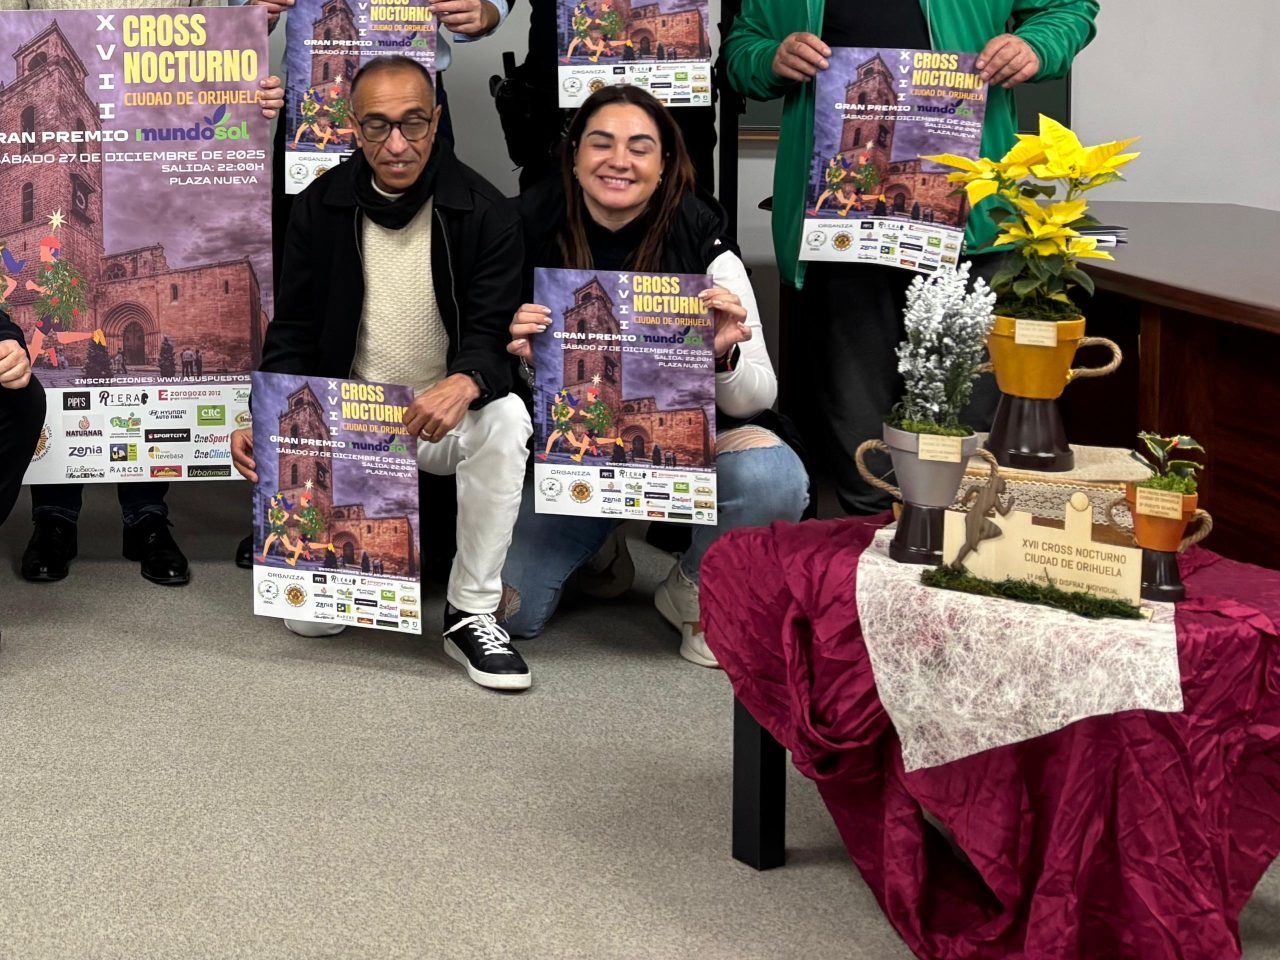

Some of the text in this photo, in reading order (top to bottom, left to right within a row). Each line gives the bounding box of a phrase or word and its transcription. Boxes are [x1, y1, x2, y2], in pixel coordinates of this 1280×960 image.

[371, 6, 433, 21] NOCTURNO
[123, 14, 206, 47] CROSS
[124, 49, 258, 84] NOCTURNO
[913, 53, 959, 69] CROSS
[911, 70, 985, 89] NOCTURNO
[124, 90, 261, 107] CIUDAD DE ORIHUELA
[867, 104, 911, 112] PREMIO
[42, 130, 129, 143] PREMIO
[59, 153, 76, 164] 27
[80, 153, 101, 163] DE
[105, 151, 198, 163] DICIEMBRE
[202, 150, 223, 160] DE
[226, 150, 265, 160] 2025
[161, 162, 264, 173] SALIDA: 22:00H
[169, 175, 258, 186] PLAZA NUEVA
[633, 275, 680, 294] CROSS
[634, 294, 709, 315] NOCTURNO
[634, 316, 661, 324] CIUDAD
[675, 318, 711, 326] ORIHUELA
[554, 331, 585, 339] GRAN
[588, 333, 636, 342] PREMIO
[74, 377, 156, 385] INSCRIPCIONES:
[99, 390, 140, 406] RIERA
[341, 382, 385, 402] CROSS
[201, 409, 221, 417] CRC
[343, 423, 367, 432] CIUDAD
[380, 426, 411, 436] ORIHUEL
[269, 435, 298, 444] GRAN
[301, 438, 345, 448] PREMIO
[1023, 539, 1126, 564] XVII CROSS NOCTURNO
[1024, 553, 1122, 577] CIUDAD DE ORIHUELA
